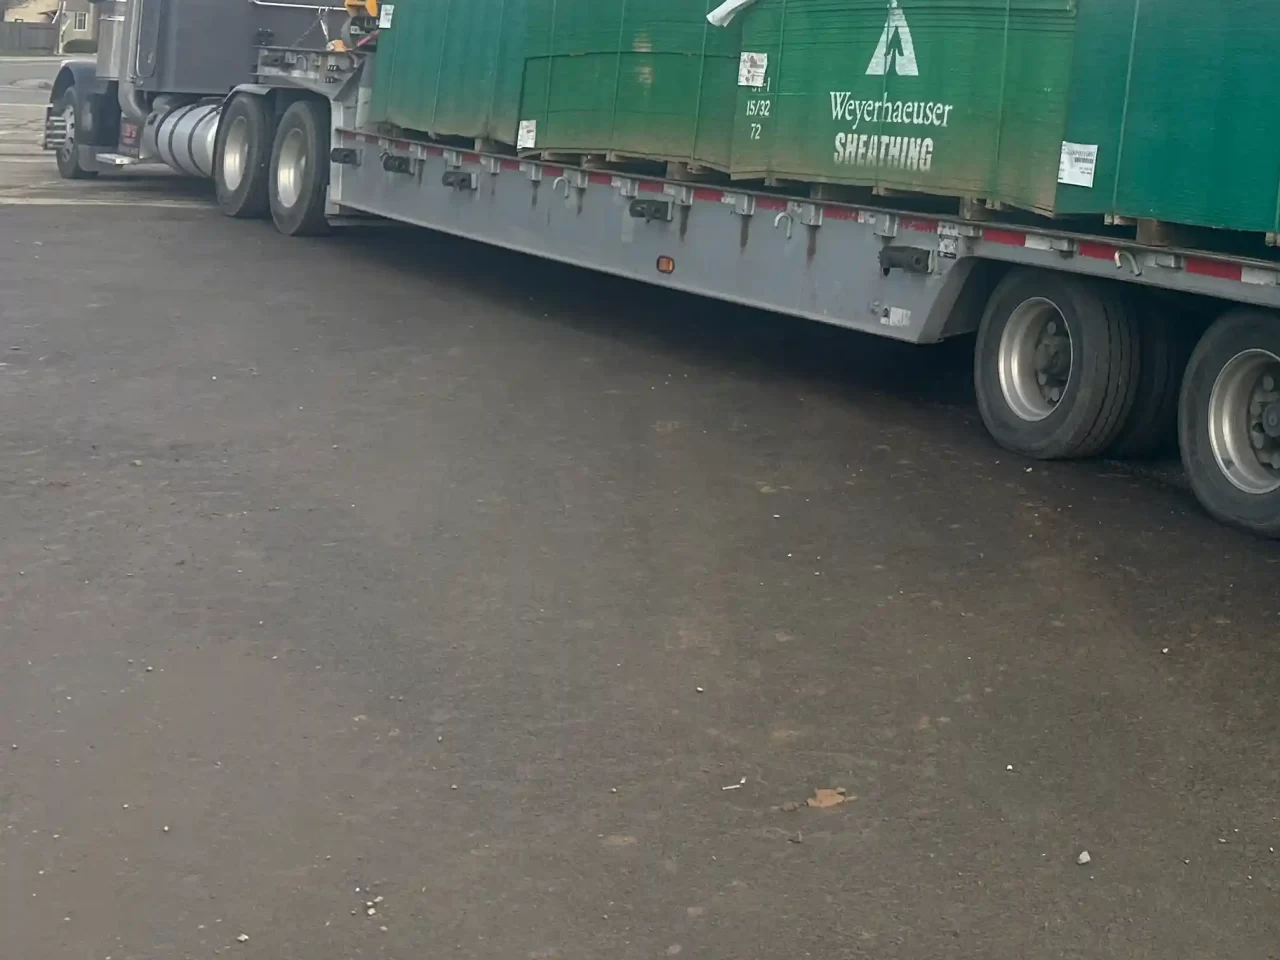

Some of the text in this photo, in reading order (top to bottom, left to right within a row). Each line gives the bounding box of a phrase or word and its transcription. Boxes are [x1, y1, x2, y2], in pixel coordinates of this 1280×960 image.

[746, 100, 771, 117] 15/32
[829, 91, 953, 130] Weyerhaeuser
[750, 123, 762, 140] 72
[833, 132, 934, 172] SHEATHING
